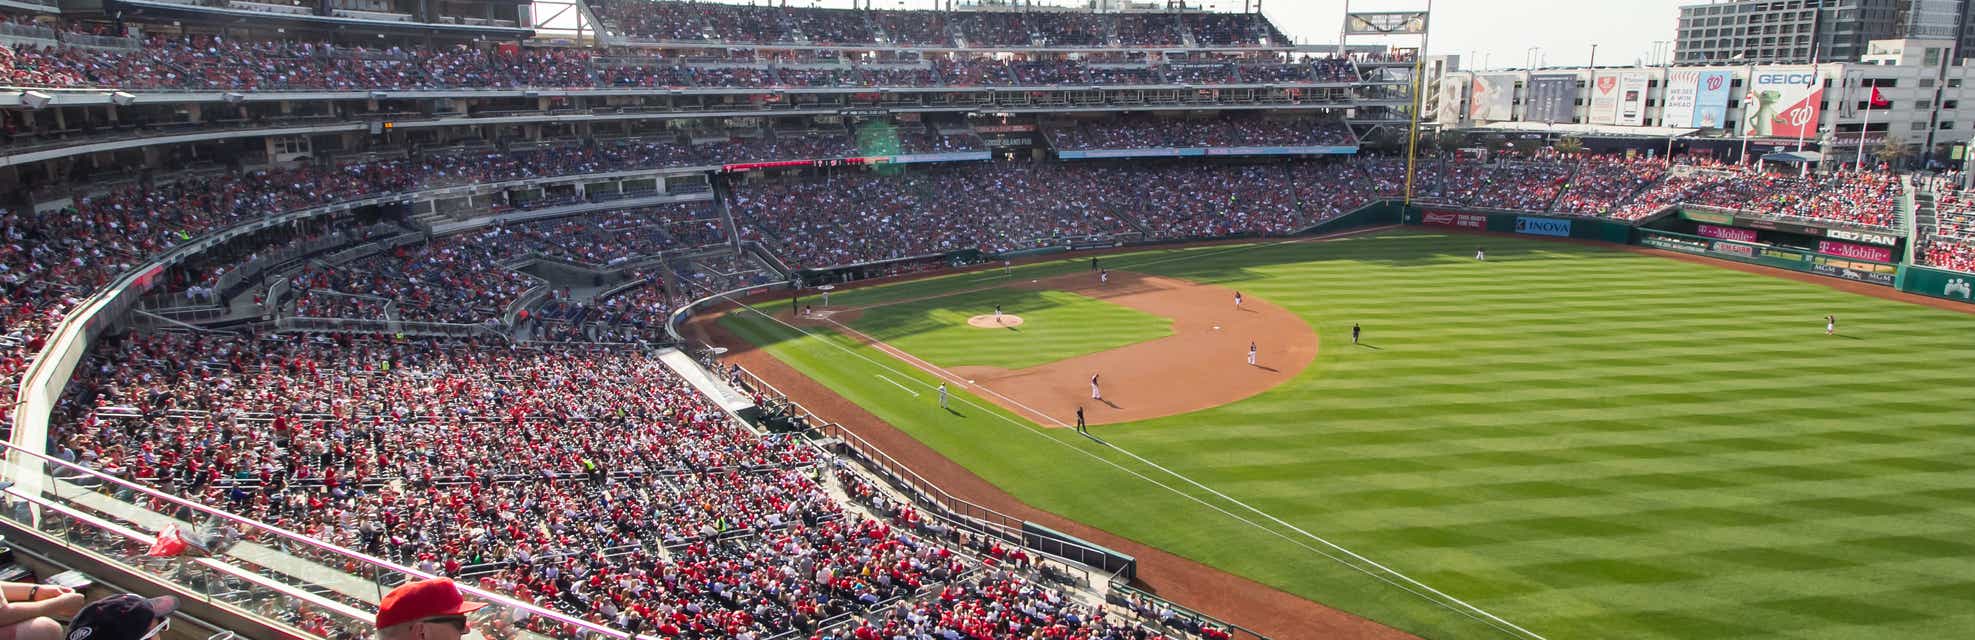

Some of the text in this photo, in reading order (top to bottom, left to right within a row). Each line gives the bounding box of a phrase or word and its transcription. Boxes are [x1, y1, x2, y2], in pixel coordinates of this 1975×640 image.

[1758, 74, 1813, 84] GEICO
[1528, 221, 1569, 232] INOVA
[1861, 234, 1896, 246] FAN
[1815, 264, 1836, 273] MGM
[1870, 272, 1891, 281] MGM
